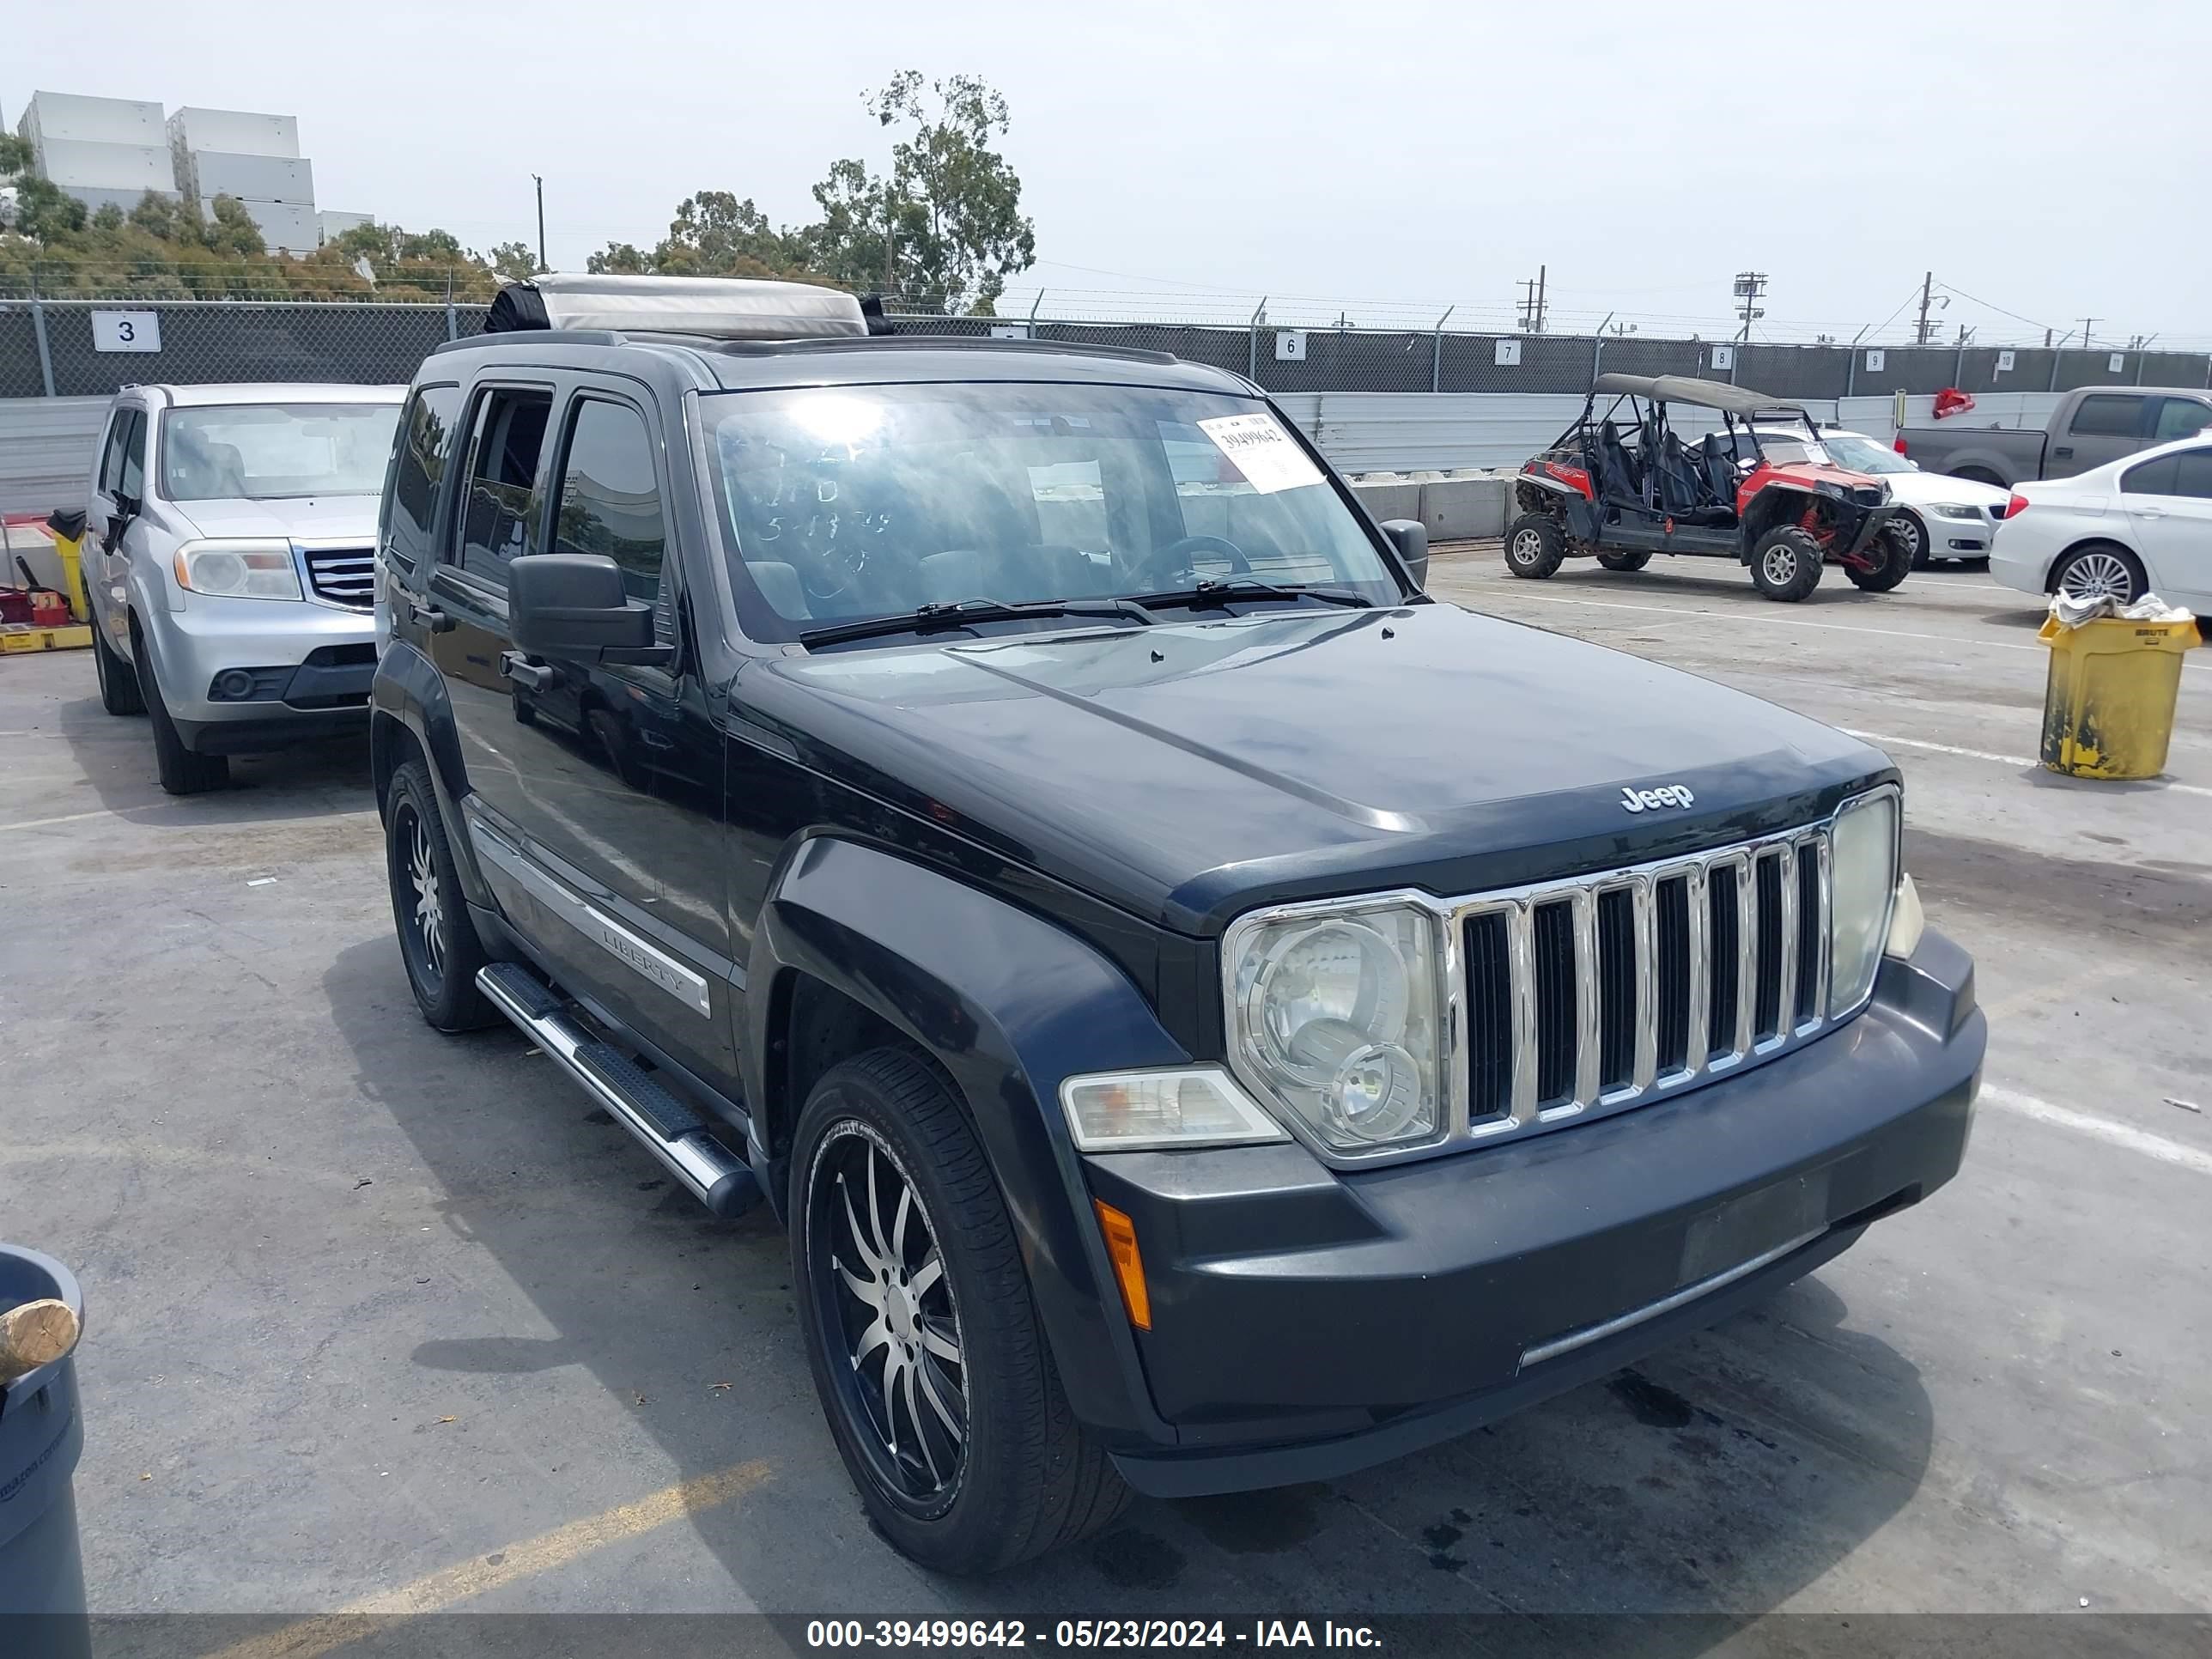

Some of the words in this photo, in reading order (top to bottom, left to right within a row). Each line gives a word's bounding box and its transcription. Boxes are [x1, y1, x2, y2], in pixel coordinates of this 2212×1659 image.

[118, 321, 135, 342] 3
[1287, 338, 1296, 354] 6
[1504, 346, 1512, 359] 7
[1719, 352, 1725, 364] 8
[1872, 356, 1878, 366] 9
[2002, 356, 2011, 366] 10
[1221, 428, 1283, 449] 39499642
[2135, 629, 2169, 637] BRUTE
[1620, 784, 1695, 814] Jeep
[604, 931, 684, 991] LIBERTY
